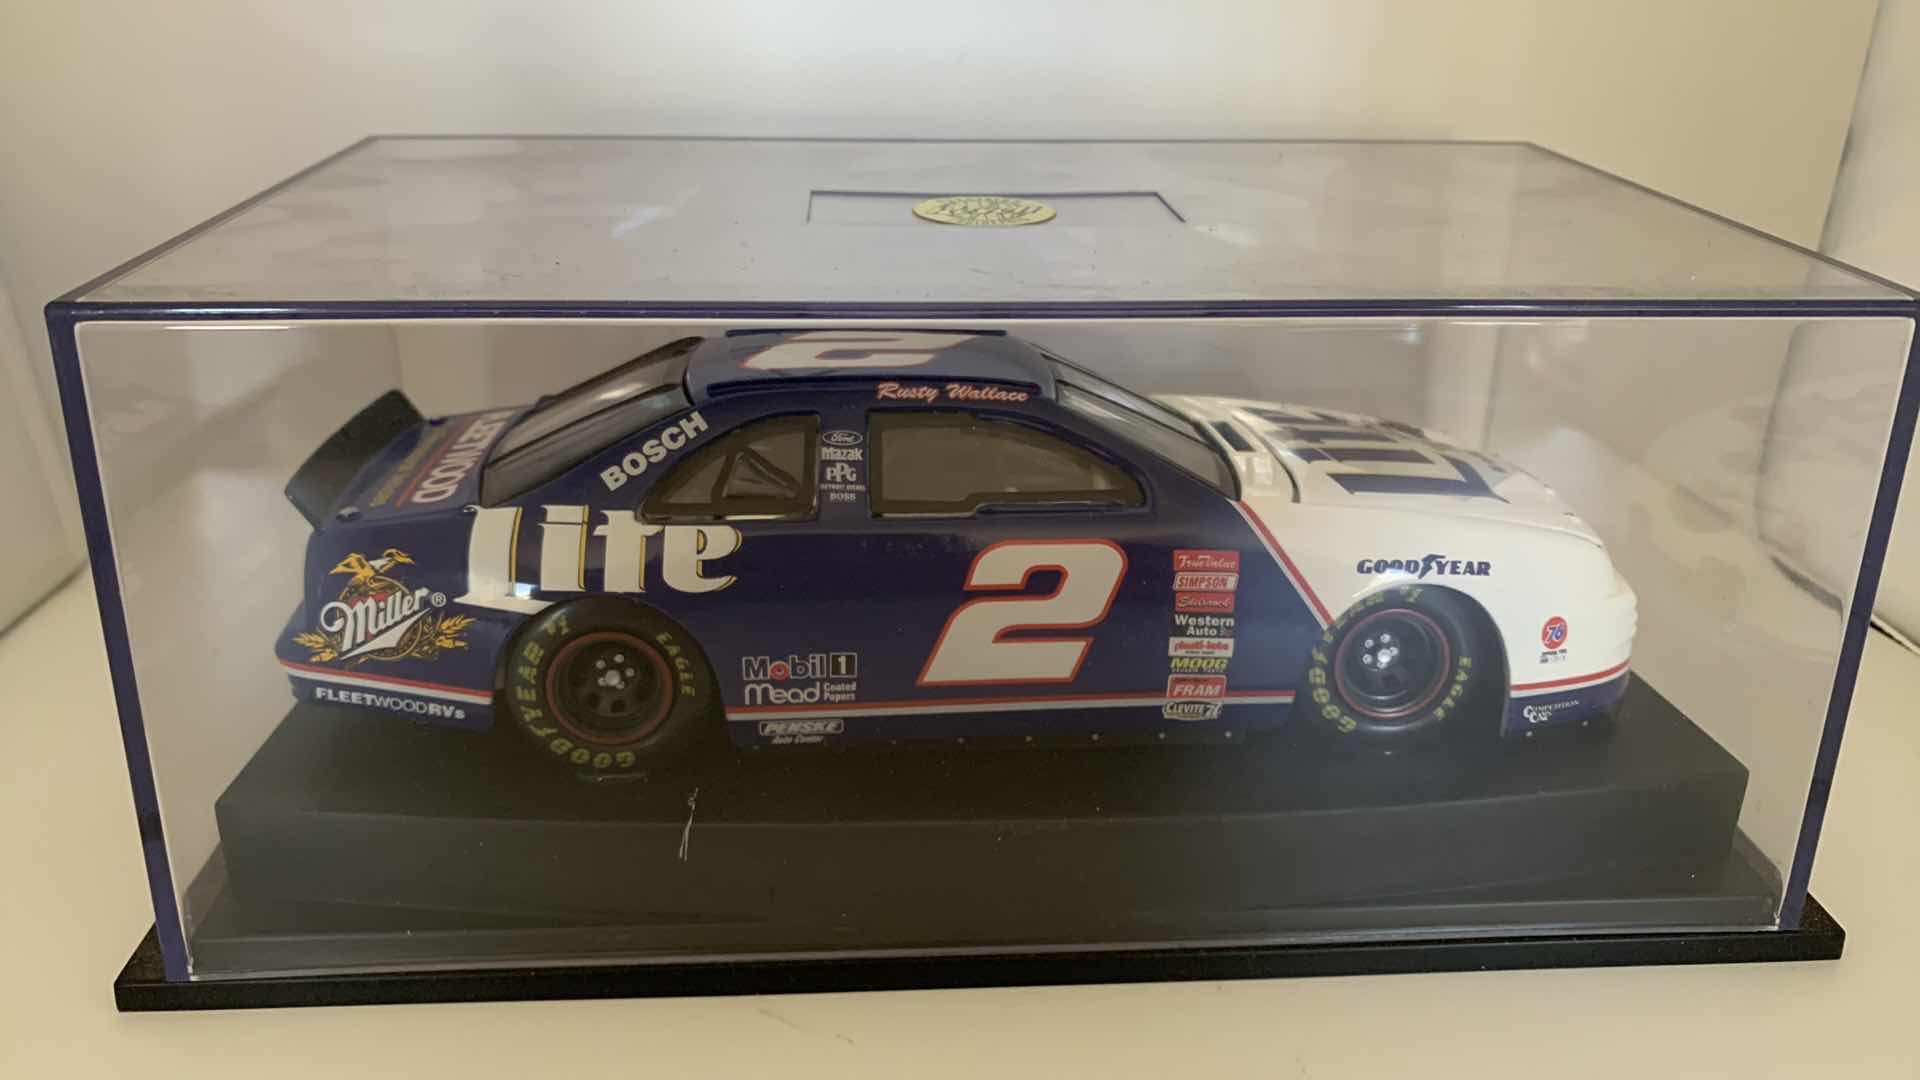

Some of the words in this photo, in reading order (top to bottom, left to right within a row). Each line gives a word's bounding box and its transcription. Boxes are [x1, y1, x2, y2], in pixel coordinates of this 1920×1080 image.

[876, 381, 939, 403] Rusty
[946, 382, 1030, 402] Wallace
[600, 411, 709, 492] BOSCH
[826, 462, 857, 482] PPG
[452, 504, 743, 616] Lite
[1356, 553, 1491, 580] GOODYEAR
[1177, 576, 1228, 588] SIMPSON
[320, 586, 431, 652] Miller
[915, 538, 1129, 686] 2
[1174, 614, 1235, 627] Western
[1186, 626, 1218, 637] Auto
[656, 631, 697, 697] EAGLE
[742, 653, 828, 681] Mobil
[1171, 658, 1228, 669] MOOG
[1173, 685, 1222, 697] FRAM
